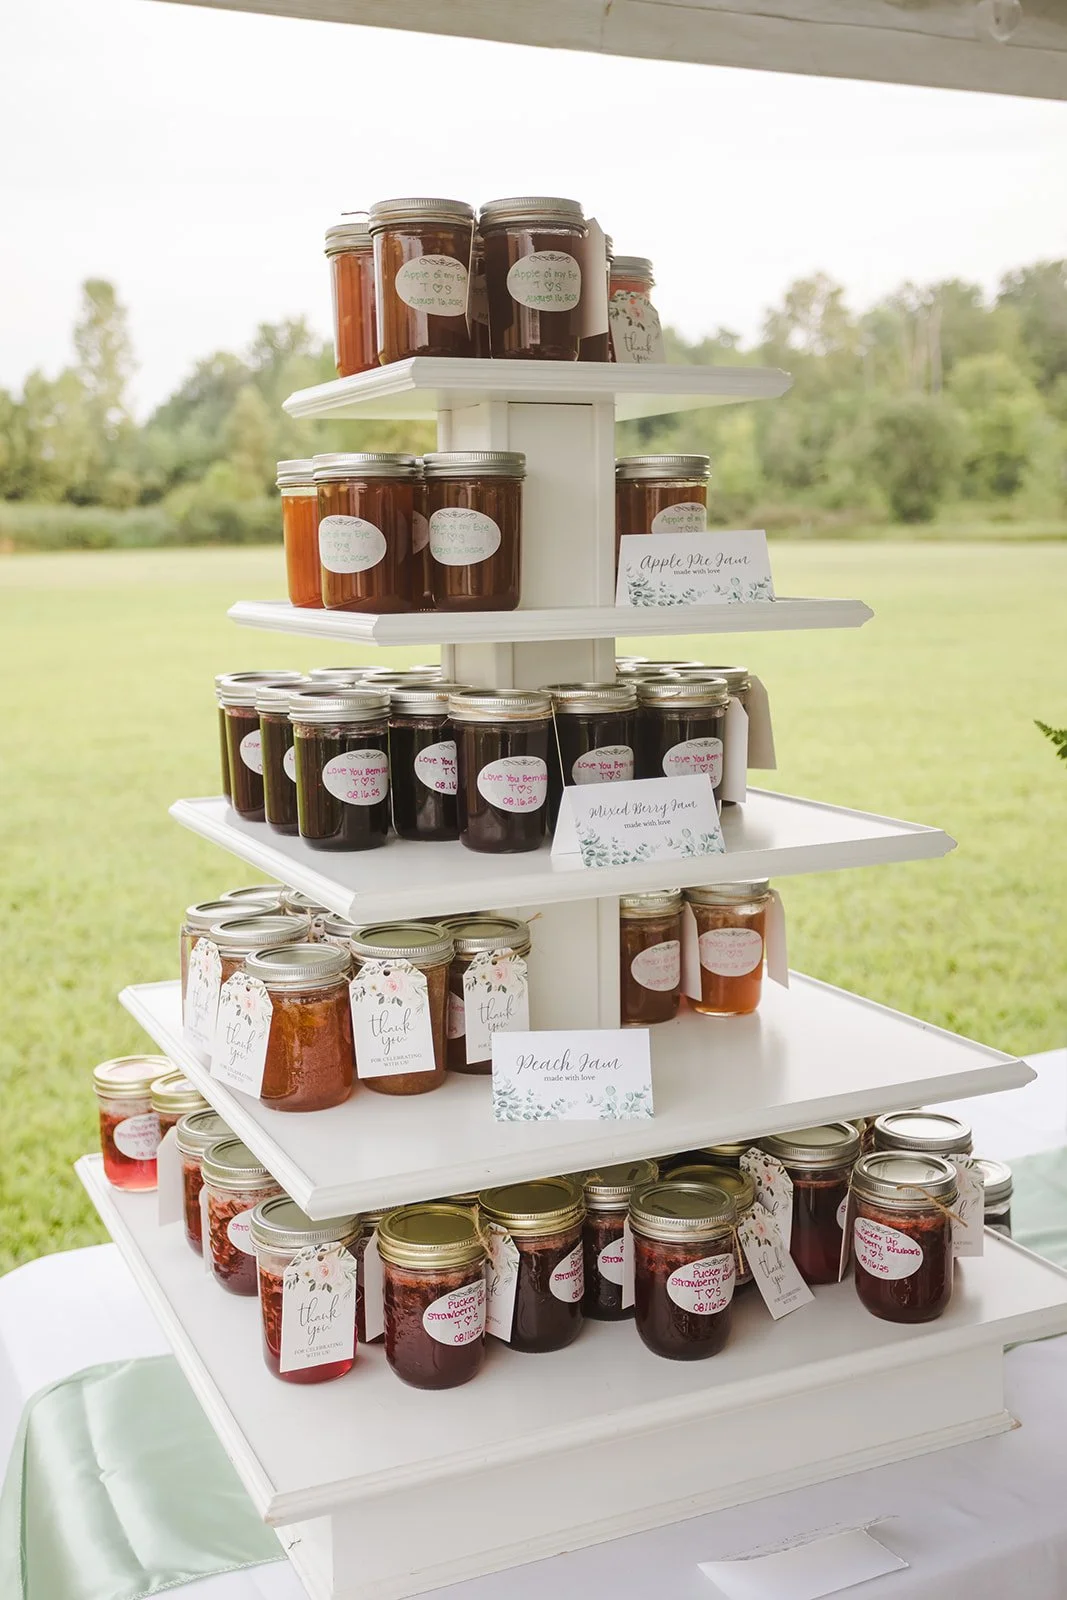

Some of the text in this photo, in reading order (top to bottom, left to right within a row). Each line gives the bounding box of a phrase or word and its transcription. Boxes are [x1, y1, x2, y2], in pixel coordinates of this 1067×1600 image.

[513, 268, 541, 281] Apple
[640, 552, 751, 574] Apple Pie Jam
[418, 756, 453, 765] Love You
[668, 755, 691, 763] Love
[692, 754, 705, 763] You
[327, 767, 347, 776] Love
[349, 768, 363, 776] You
[443, 767, 450, 775] T
[577, 762, 597, 770] Love
[598, 761, 612, 770] You
[482, 773, 503, 782] Love
[506, 774, 520, 783] You
[599, 770, 621, 780] T S
[352, 777, 376, 786] T S
[434, 781, 457, 790] 08.16
[508, 783, 533, 795] T S
[502, 795, 538, 806] 08.16.25
[589, 798, 698, 819] Mixed Berry Jam
[623, 818, 672, 829] made with love
[478, 994, 516, 1025] thank
[368, 1008, 416, 1037] thank
[487, 1020, 510, 1041] you
[226, 1022, 256, 1054] thank
[381, 1036, 408, 1056] you
[229, 1046, 249, 1066] you
[382, 1053, 423, 1062] CELEBRATING
[516, 1048, 623, 1075] Peach Jam
[543, 1073, 596, 1082] made with love
[886, 1236, 899, 1248] Up
[758, 1246, 786, 1279] thank
[693, 1267, 721, 1279] Pucker
[671, 1277, 720, 1288] Strawberry
[694, 1286, 722, 1300] T S
[297, 1294, 342, 1327] thank
[427, 1304, 477, 1321] Strawberry
[453, 1319, 462, 1329] T
[473, 1312, 479, 1322] S
[307, 1324, 333, 1346] you
